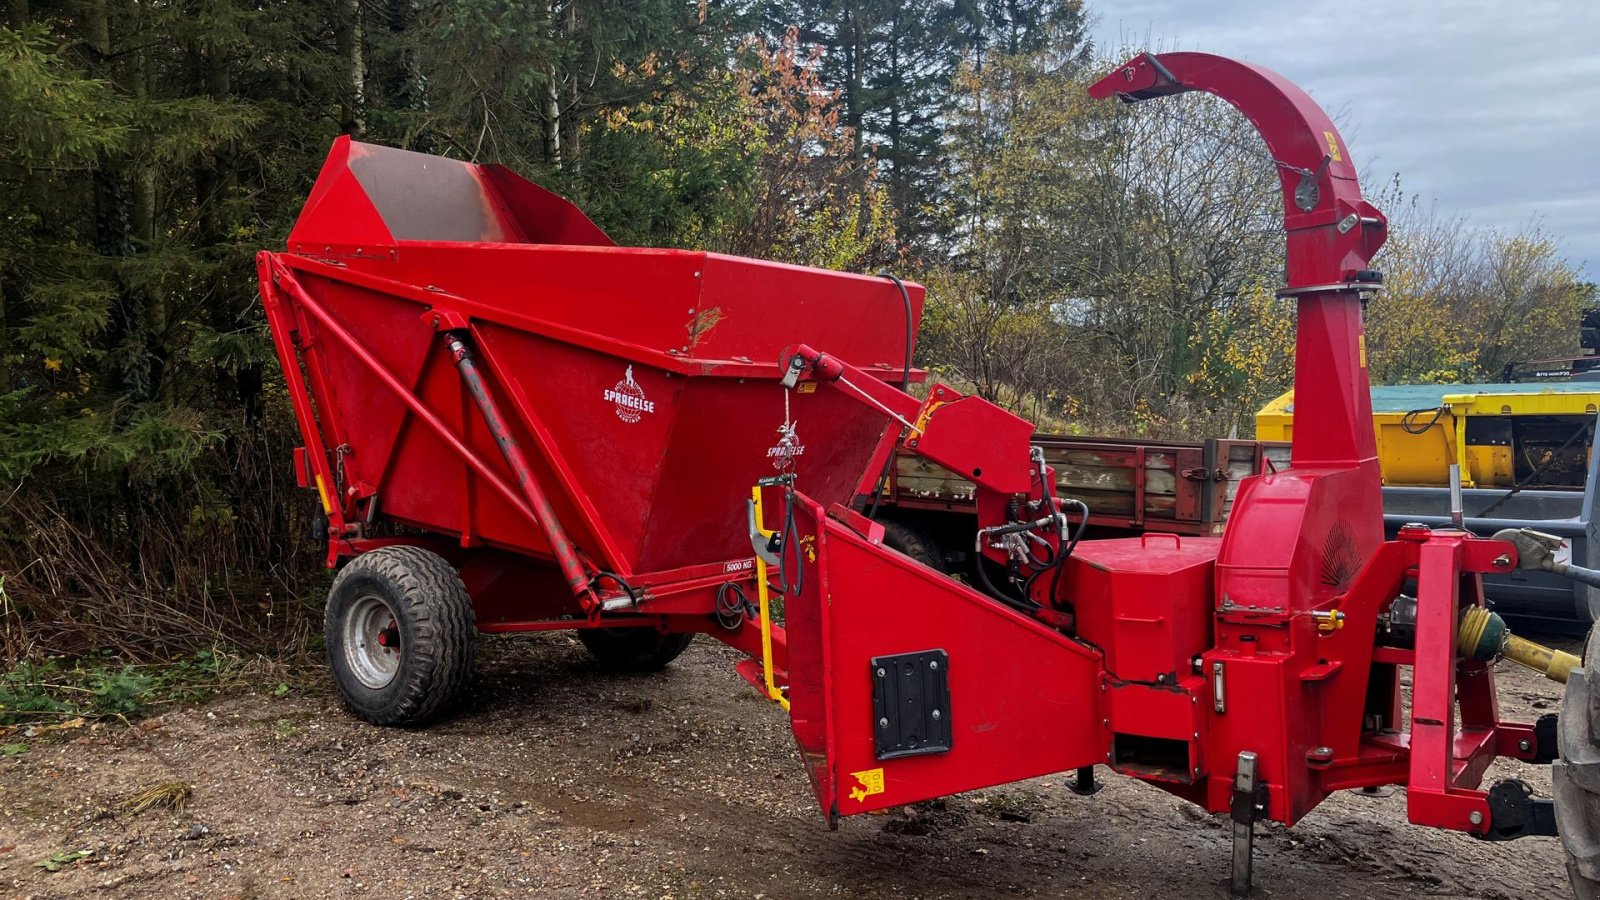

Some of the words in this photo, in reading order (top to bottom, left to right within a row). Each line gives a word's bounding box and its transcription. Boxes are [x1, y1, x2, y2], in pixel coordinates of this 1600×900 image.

[1120, 66, 1135, 82] TP
[603, 389, 655, 413] SPRAGELSE
[766, 445, 805, 458] SPRAELSE
[726, 562, 742, 572] 5000
